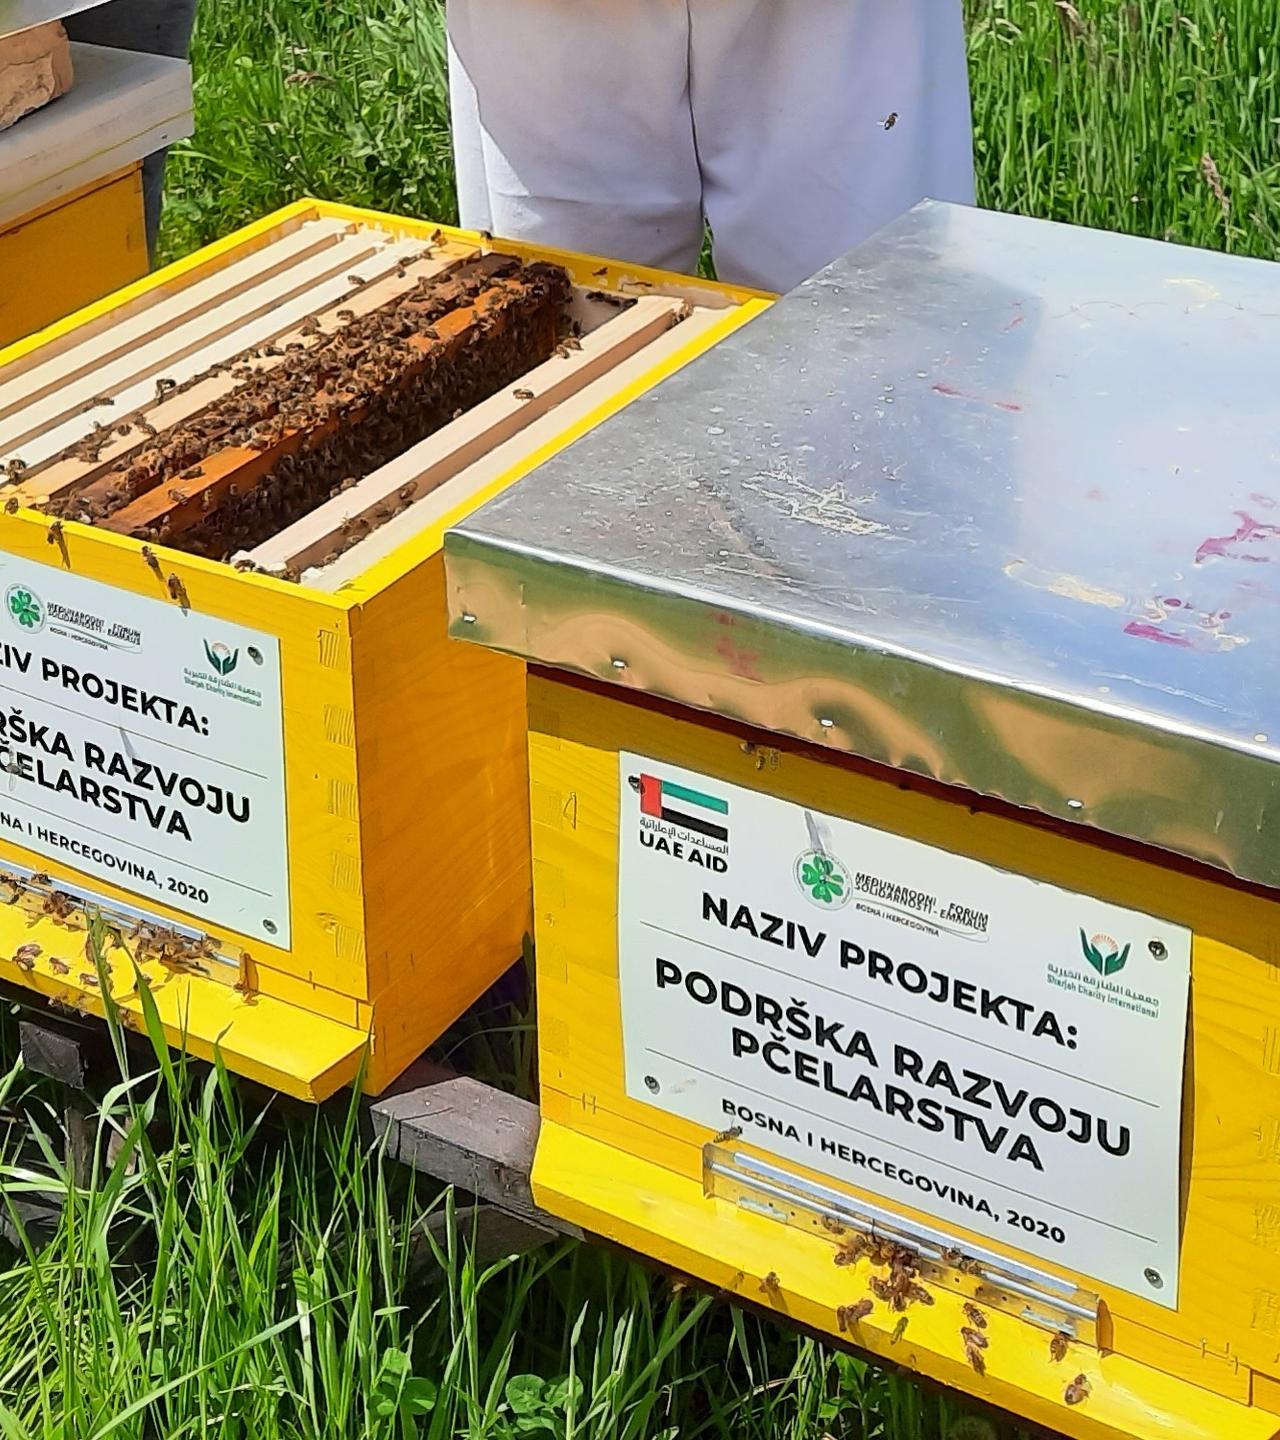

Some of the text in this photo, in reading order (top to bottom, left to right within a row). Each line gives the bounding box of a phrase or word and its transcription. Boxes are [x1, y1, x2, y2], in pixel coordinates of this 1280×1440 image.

[42, 658, 209, 736] PROJEKTA:
[84, 741, 250, 824] RAZVOJU
[28, 823, 32, 835] I
[37, 826, 163, 888] HERCEGOVINA,
[167, 876, 209, 904] 2020
[640, 829, 728, 873] UAE AID
[949, 903, 989, 922] FORUM
[702, 892, 1079, 1050] NAZIV PROJEKTA:
[656, 958, 1131, 1157] PODRŠKA RAZVOJU
[732, 1028, 1045, 1171] PČELARSTVA
[721, 1099, 1066, 1245] BOSNA I HERCEGOVINA, 2020
